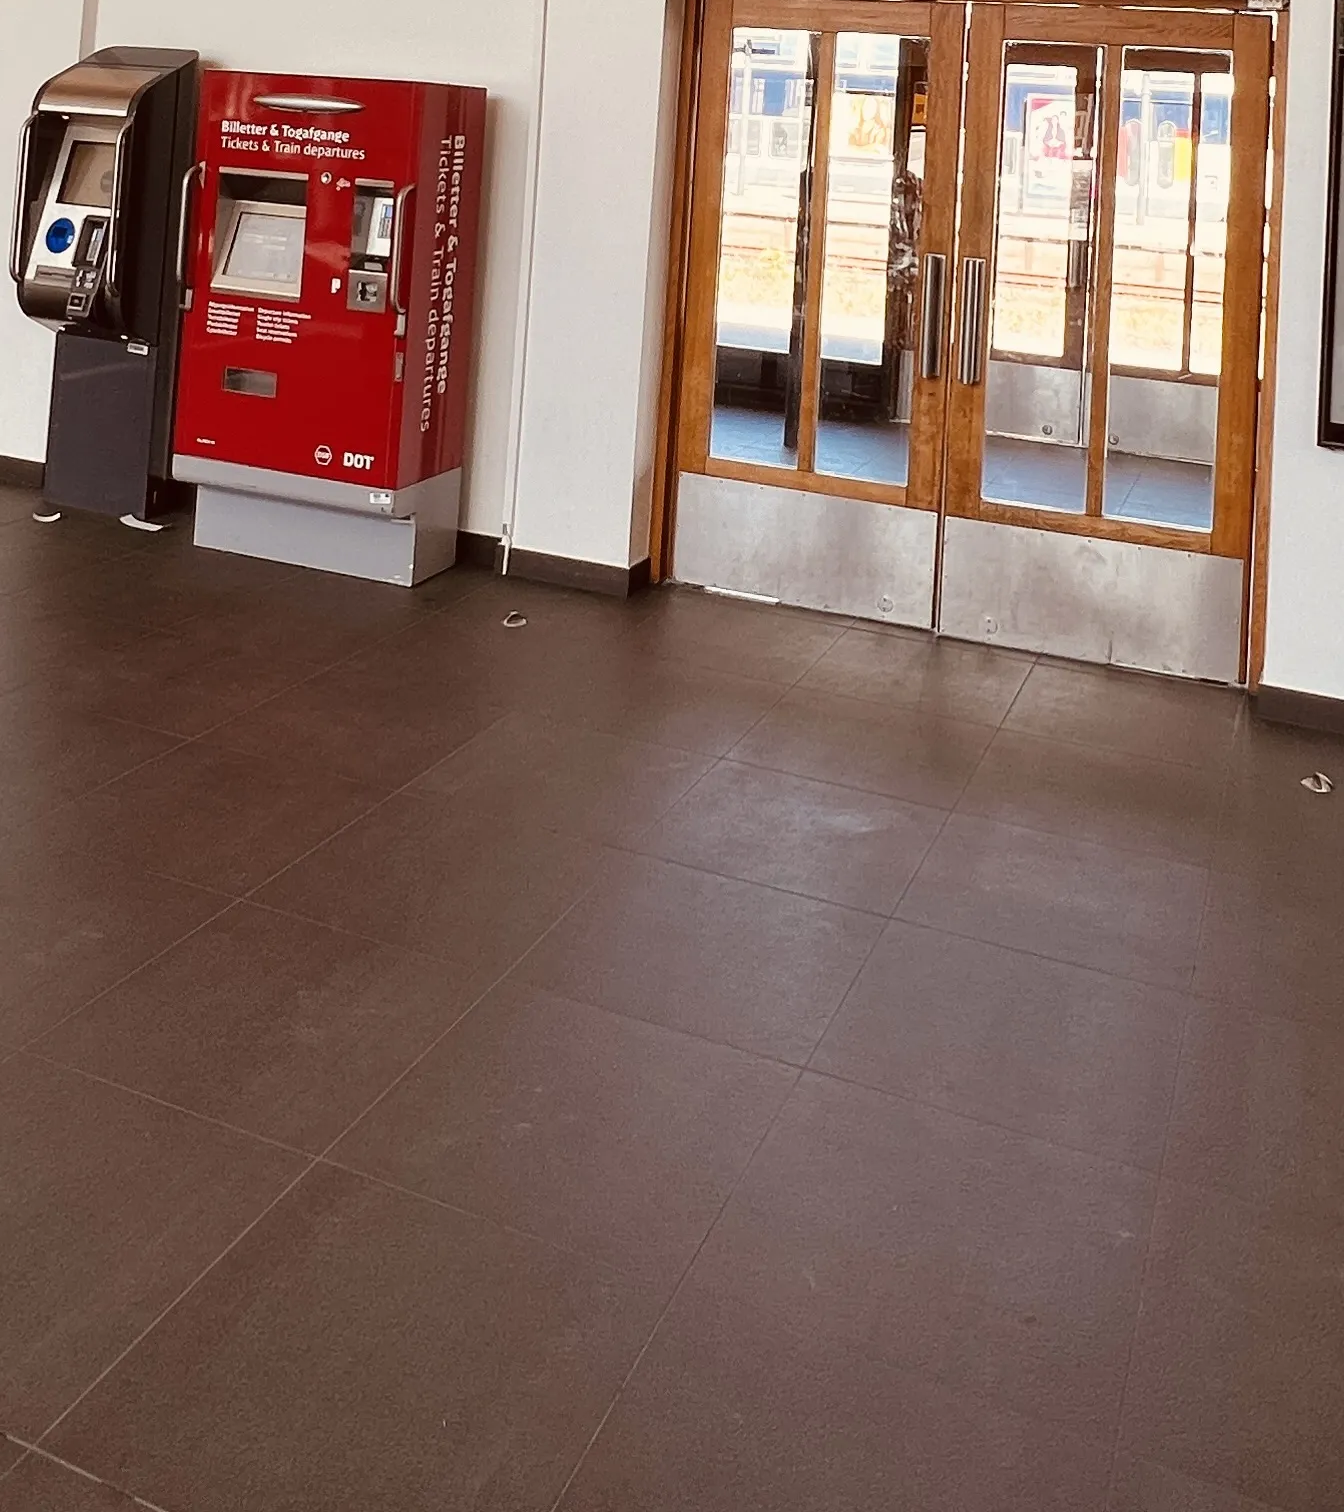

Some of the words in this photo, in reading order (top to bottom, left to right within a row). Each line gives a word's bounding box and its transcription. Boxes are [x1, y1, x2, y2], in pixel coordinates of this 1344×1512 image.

[221, 120, 268, 135] Billetter
[270, 124, 279, 137] &
[281, 124, 350, 144] Togafgange
[221, 136, 258, 151] Tickets
[261, 140, 270, 152] &
[274, 140, 301, 154] Train
[303, 143, 366, 160] departures
[435, 135, 452, 215] Tickets
[447, 135, 466, 229] Billetter
[434, 223, 446, 239] &
[447, 235, 459, 249] &
[430, 246, 444, 302] Train
[436, 257, 457, 395] Togafgange
[420, 308, 440, 433] departures
[343, 452, 374, 469] DOT
